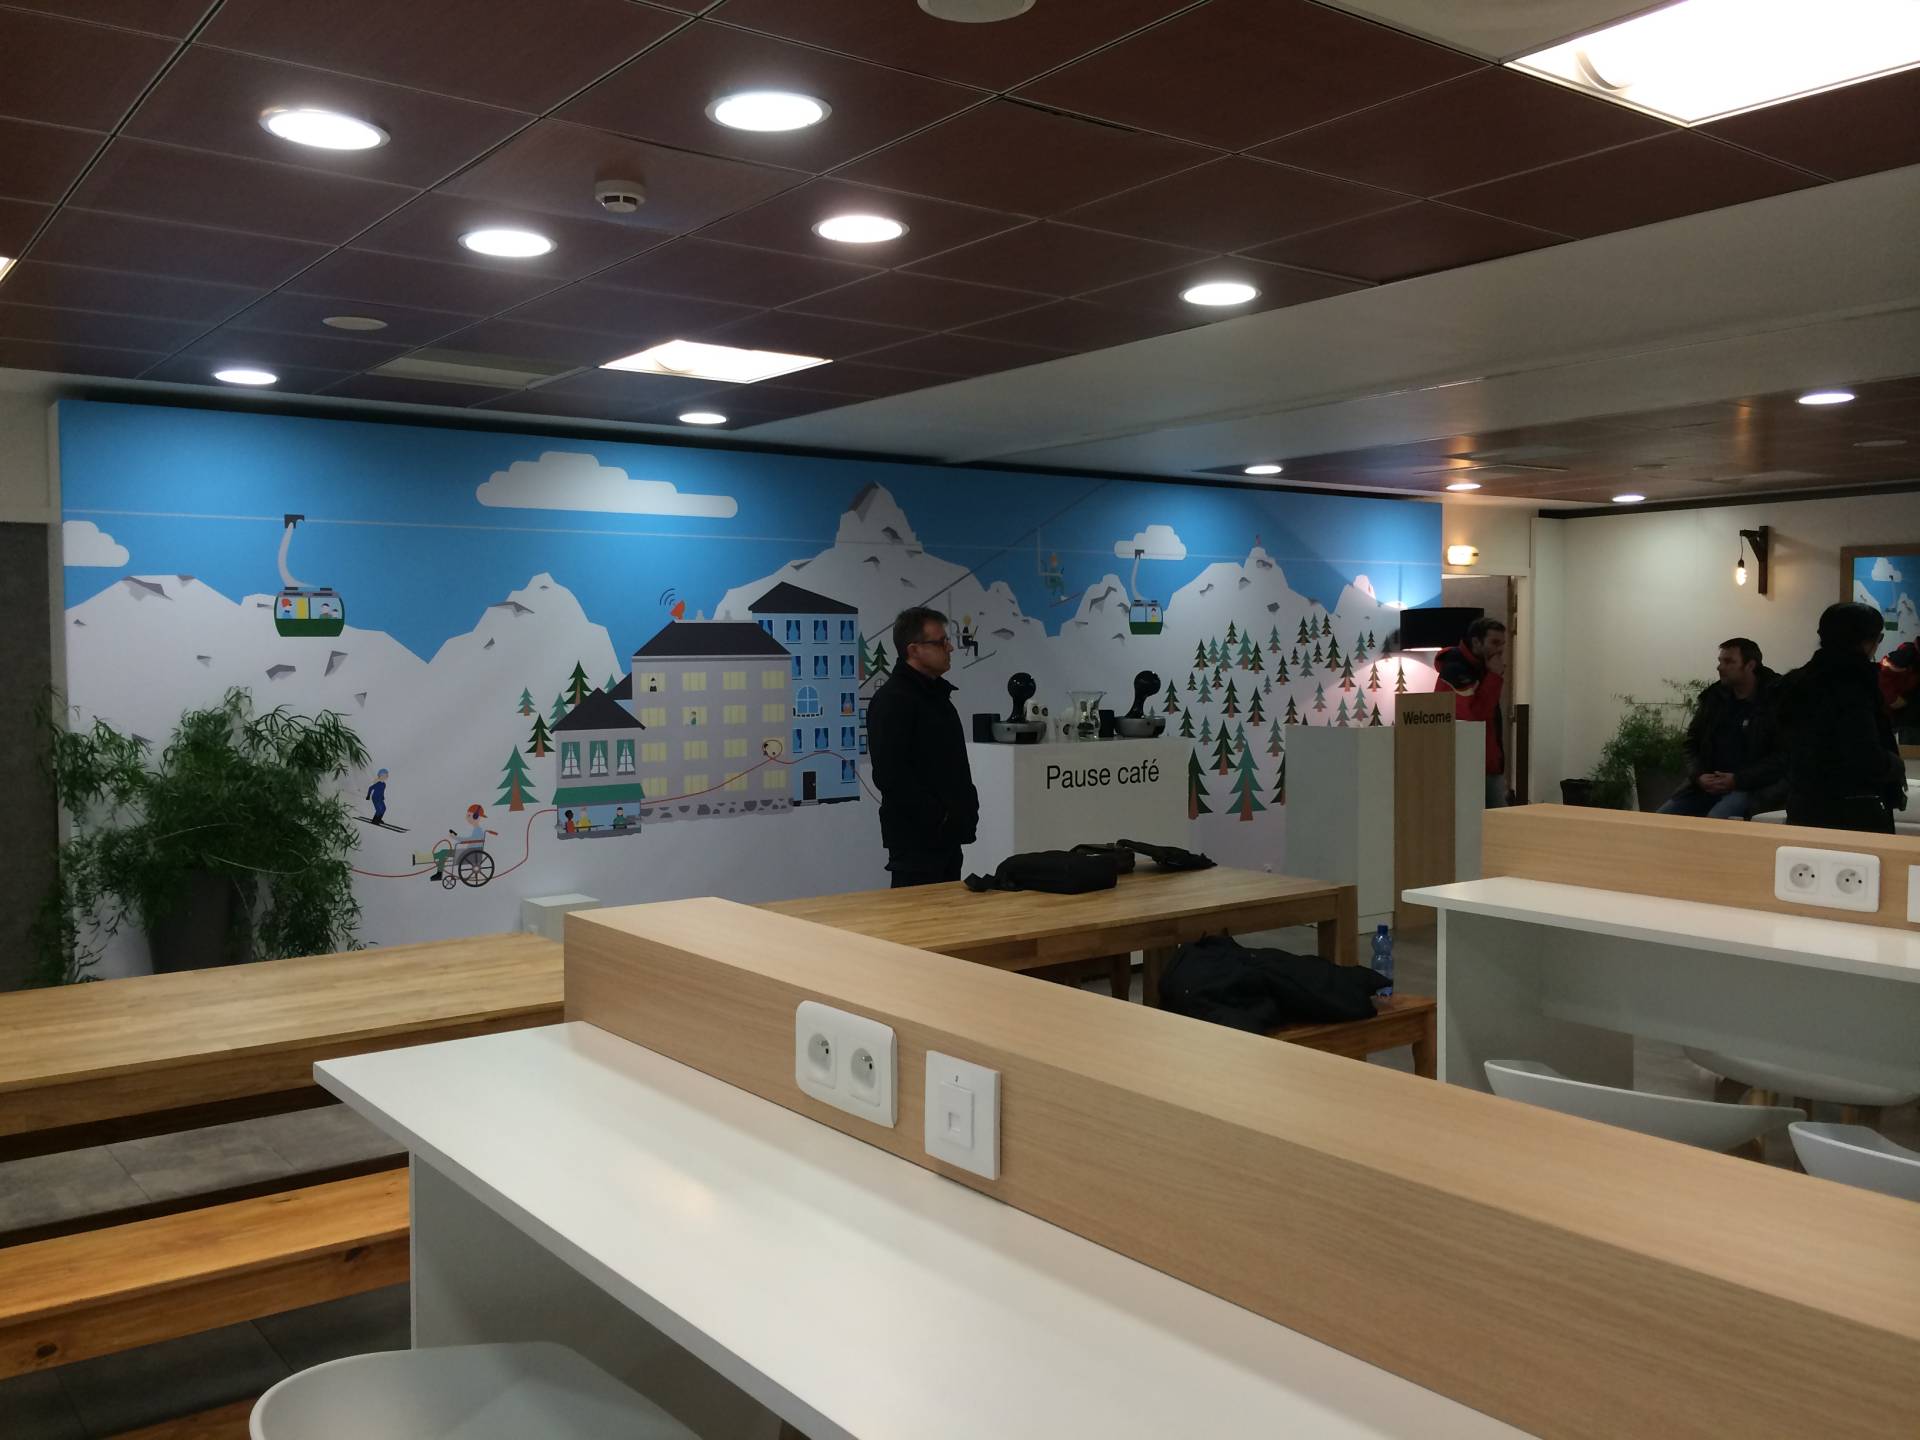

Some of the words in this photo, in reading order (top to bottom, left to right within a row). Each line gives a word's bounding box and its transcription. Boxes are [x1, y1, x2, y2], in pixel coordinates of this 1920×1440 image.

[1402, 711, 1452, 725] Welcome
[1046, 765, 1111, 789] Pause
[1117, 759, 1160, 784] café
